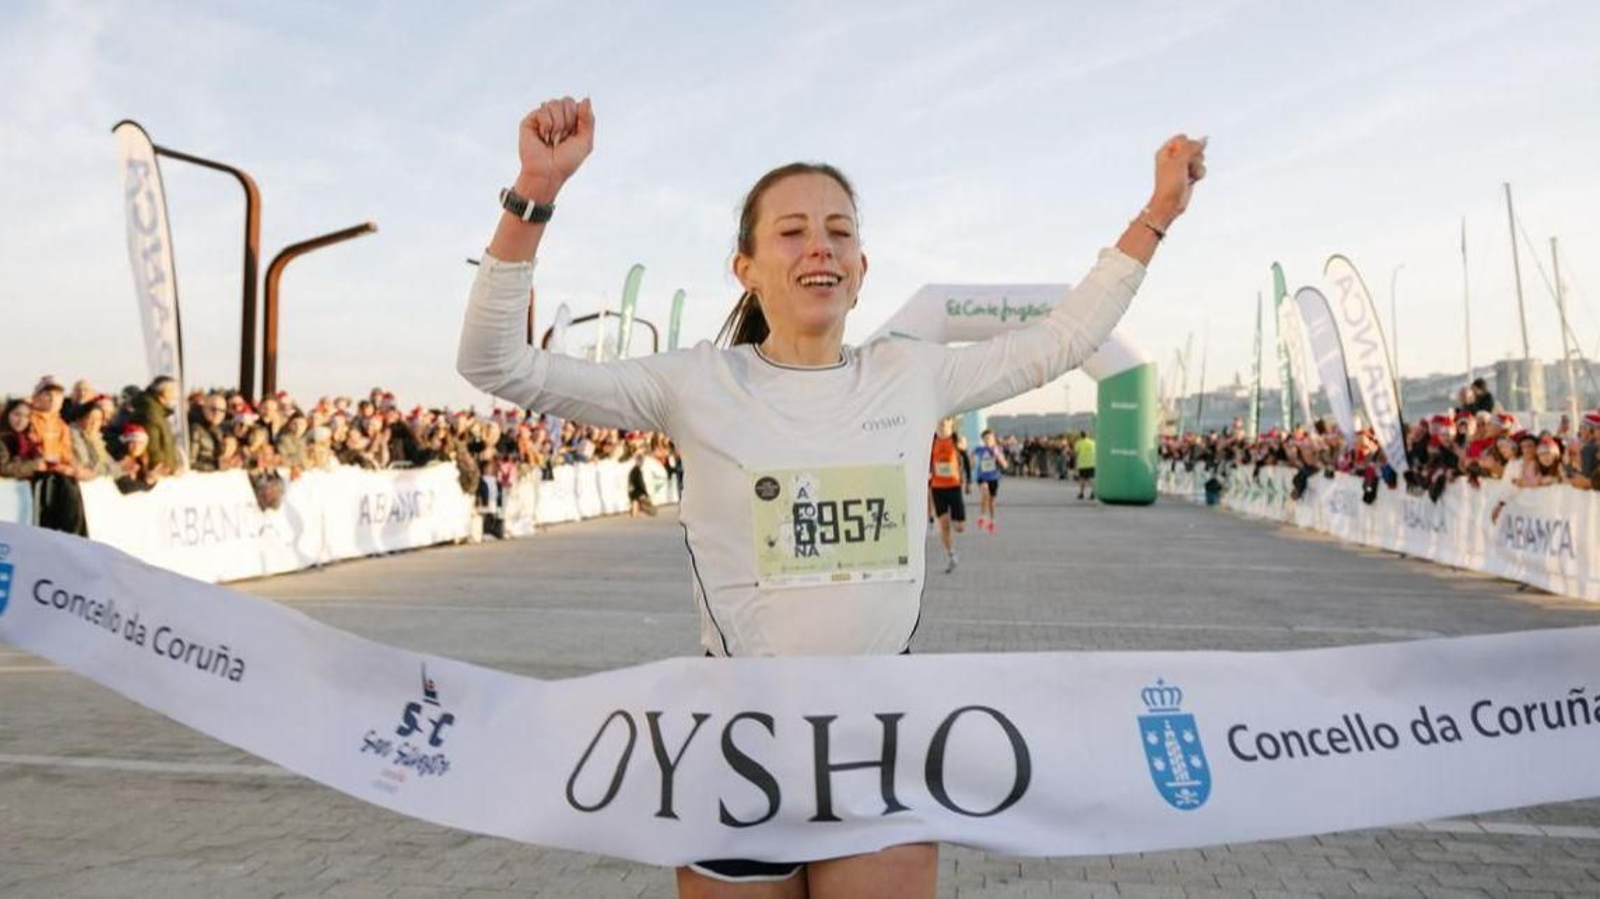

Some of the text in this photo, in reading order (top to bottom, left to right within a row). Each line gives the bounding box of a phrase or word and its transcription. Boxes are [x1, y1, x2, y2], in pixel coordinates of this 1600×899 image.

[861, 416, 906, 431] OYSHO
[1504, 512, 1574, 560] ABANCA
[32, 578, 246, 682] Concello da Coruña
[1227, 711, 1400, 762] Concello
[1410, 705, 1462, 745] da
[566, 705, 1032, 828] OYSHO
